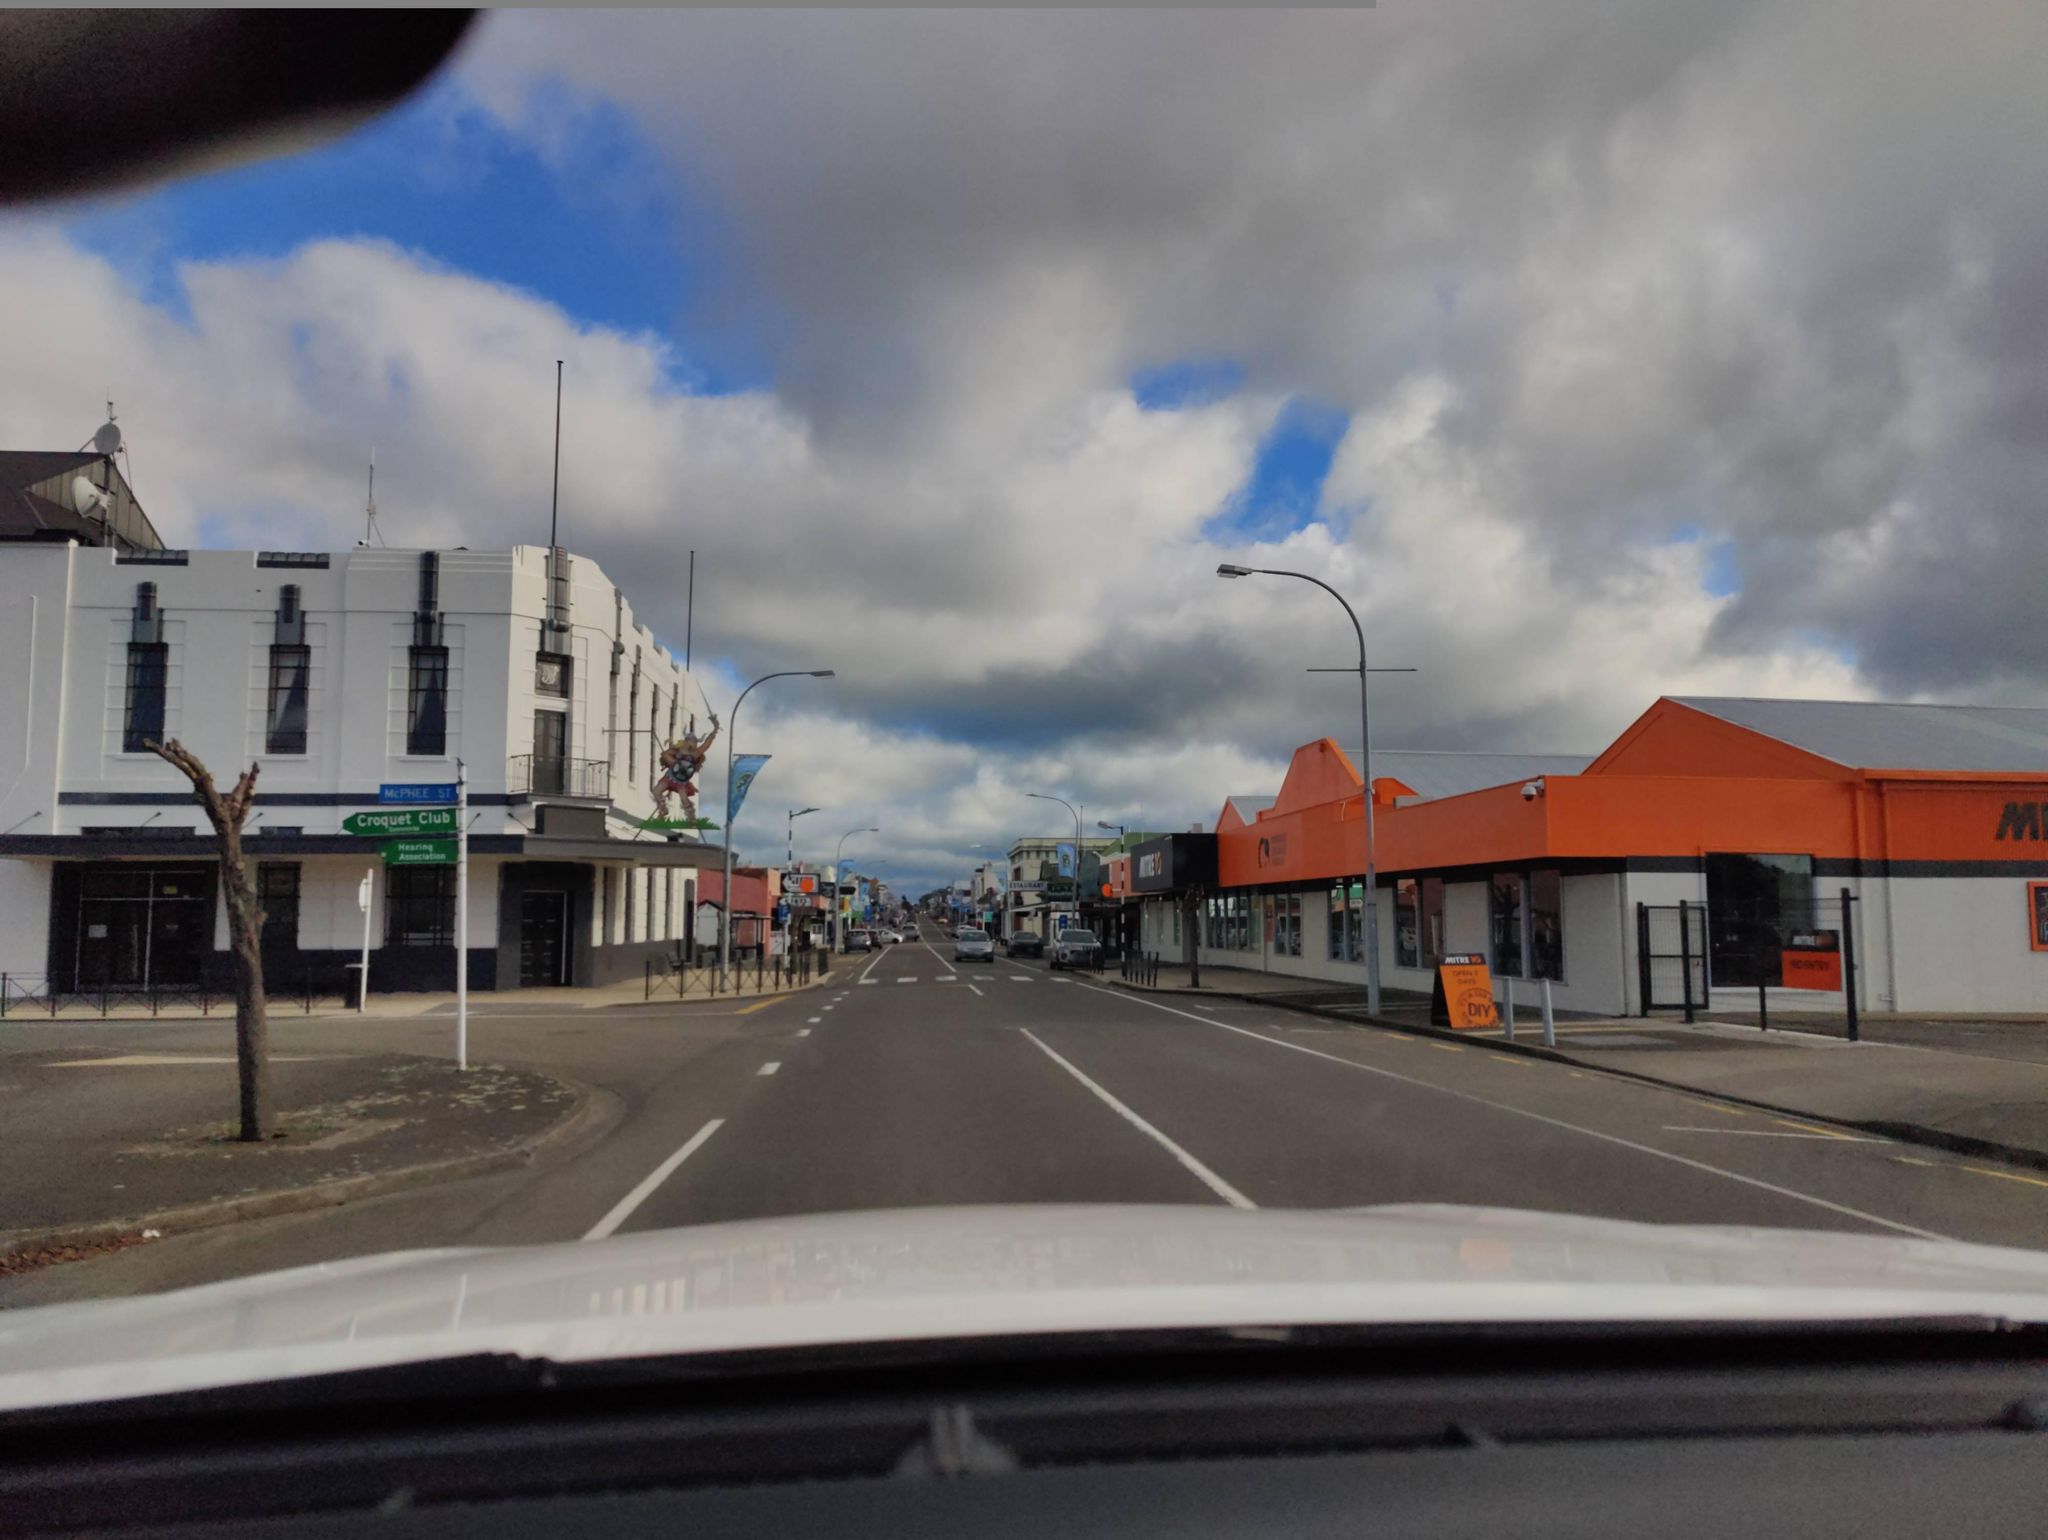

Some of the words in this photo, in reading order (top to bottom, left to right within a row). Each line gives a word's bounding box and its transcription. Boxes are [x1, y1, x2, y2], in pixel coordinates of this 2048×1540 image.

[384, 788, 430, 799] McPHEE
[438, 788, 451, 798] ST
[357, 813, 412, 829] Croquet
[419, 812, 450, 824] Club
[398, 843, 433, 852] Hearing
[399, 852, 446, 861] Association
[1008, 881, 1045, 889] ESTAURANT
[1468, 1002, 1491, 1017] DIY
